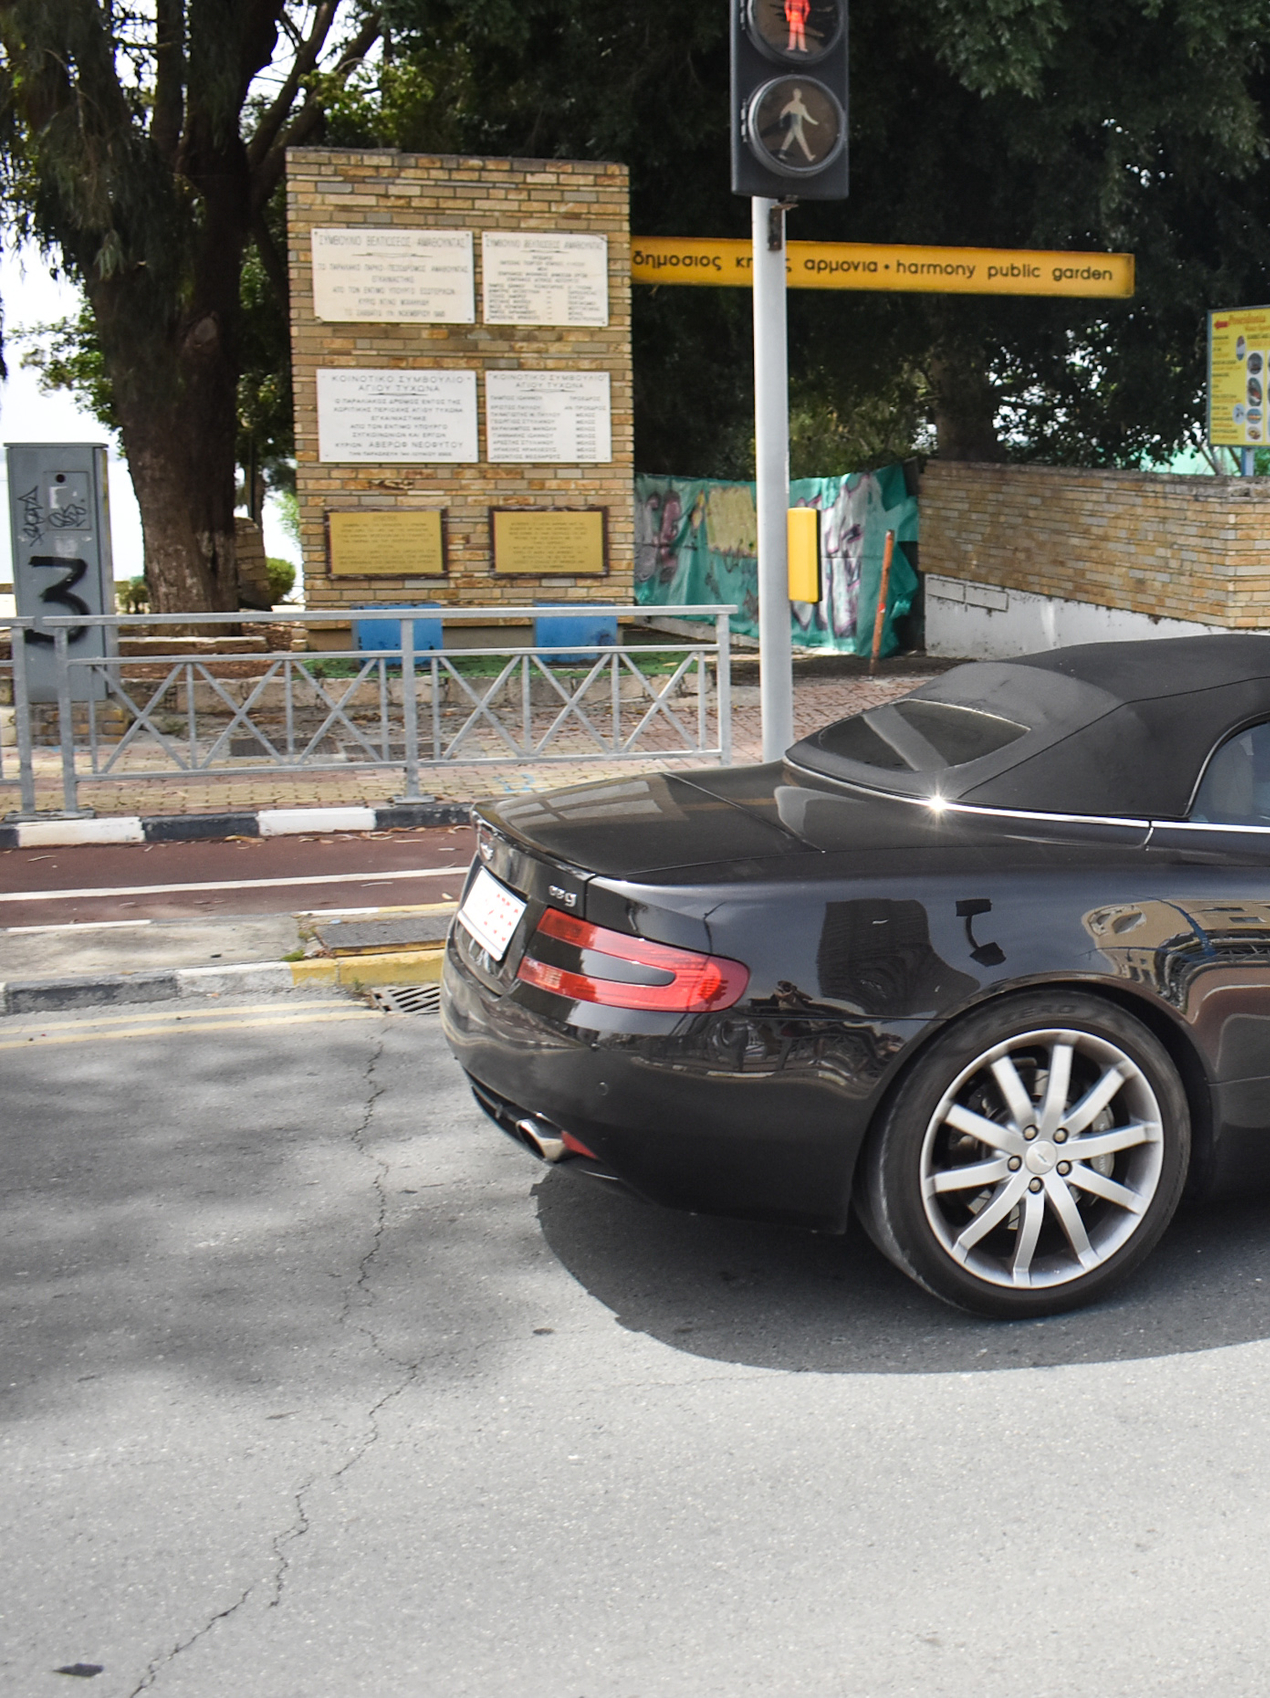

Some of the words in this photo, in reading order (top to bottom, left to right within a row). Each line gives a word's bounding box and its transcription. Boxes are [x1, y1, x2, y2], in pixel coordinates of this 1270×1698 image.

[632, 250, 722, 271] δημοσιος
[803, 259, 878, 274] αρμονια
[896, 260, 976, 279] harmony
[987, 264, 1041, 280] public
[1052, 266, 1113, 282] garden
[332, 375, 394, 383] ΚΟΙΝΟΤΙΚΟ
[399, 376, 464, 384] ΣΥΜΒΟΥΛΙΟ
